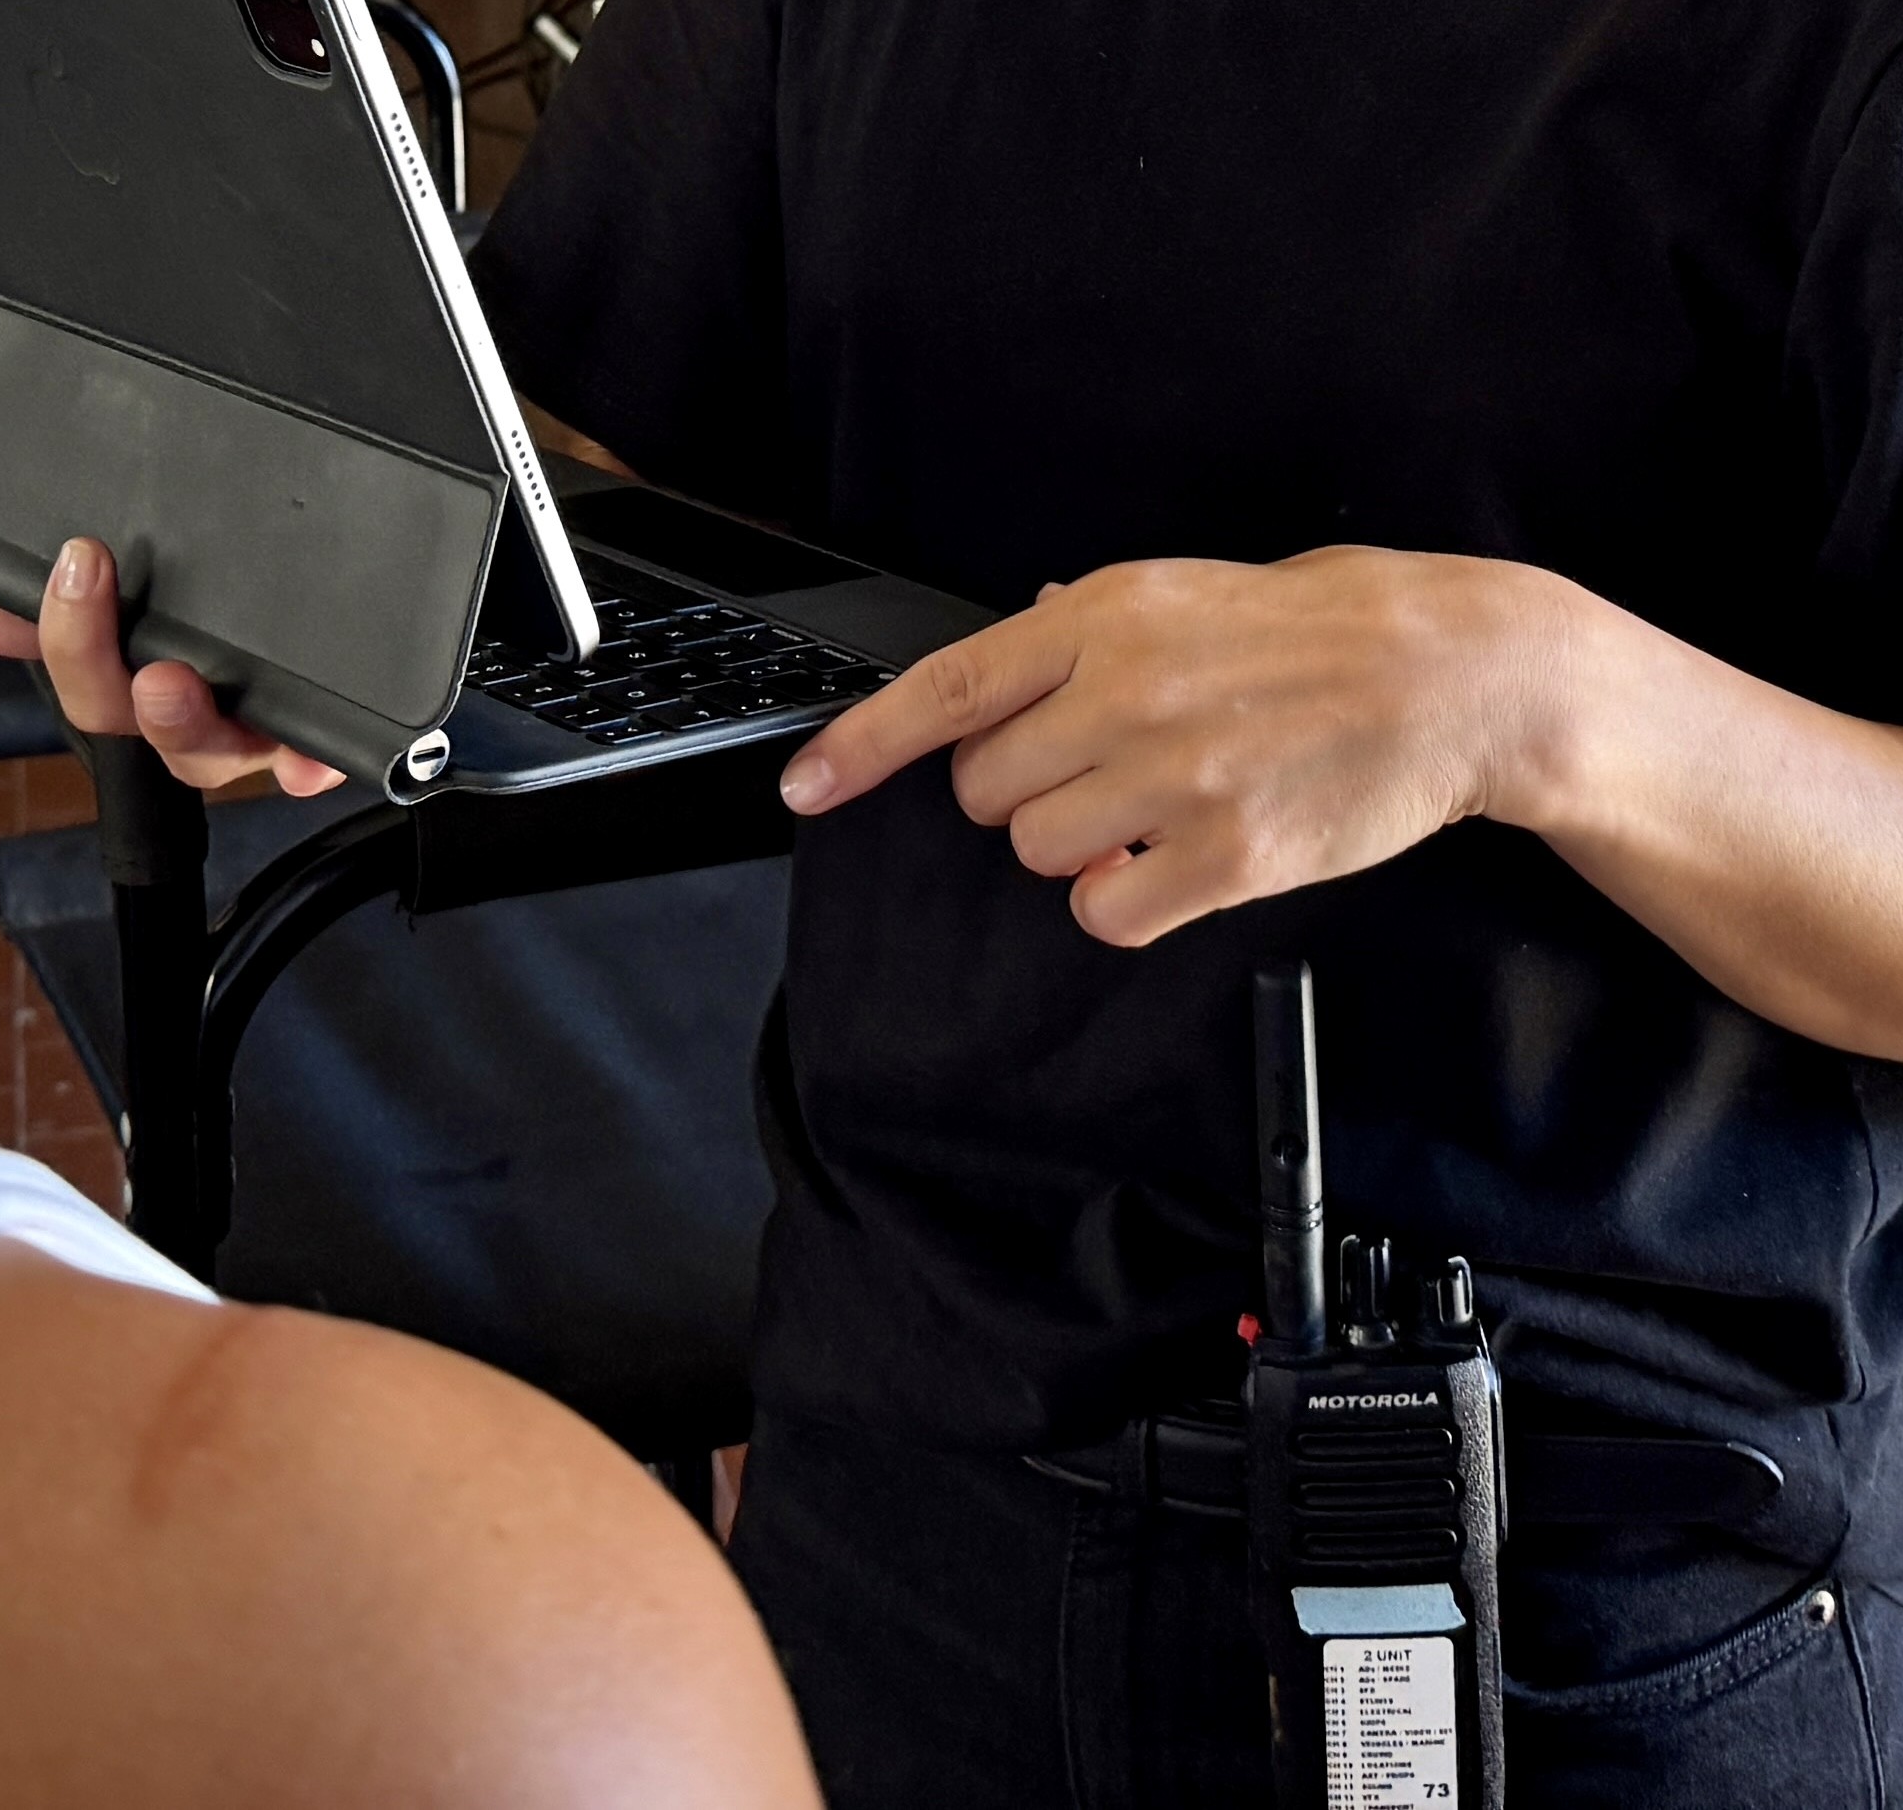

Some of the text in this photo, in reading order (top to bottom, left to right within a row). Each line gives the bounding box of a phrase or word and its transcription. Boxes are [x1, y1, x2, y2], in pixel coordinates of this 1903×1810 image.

[1308, 1391, 1439, 1409] MOTOROLA
[1364, 1649, 1412, 1662] 2 UNIT
[1422, 1782, 1450, 1798] 73
